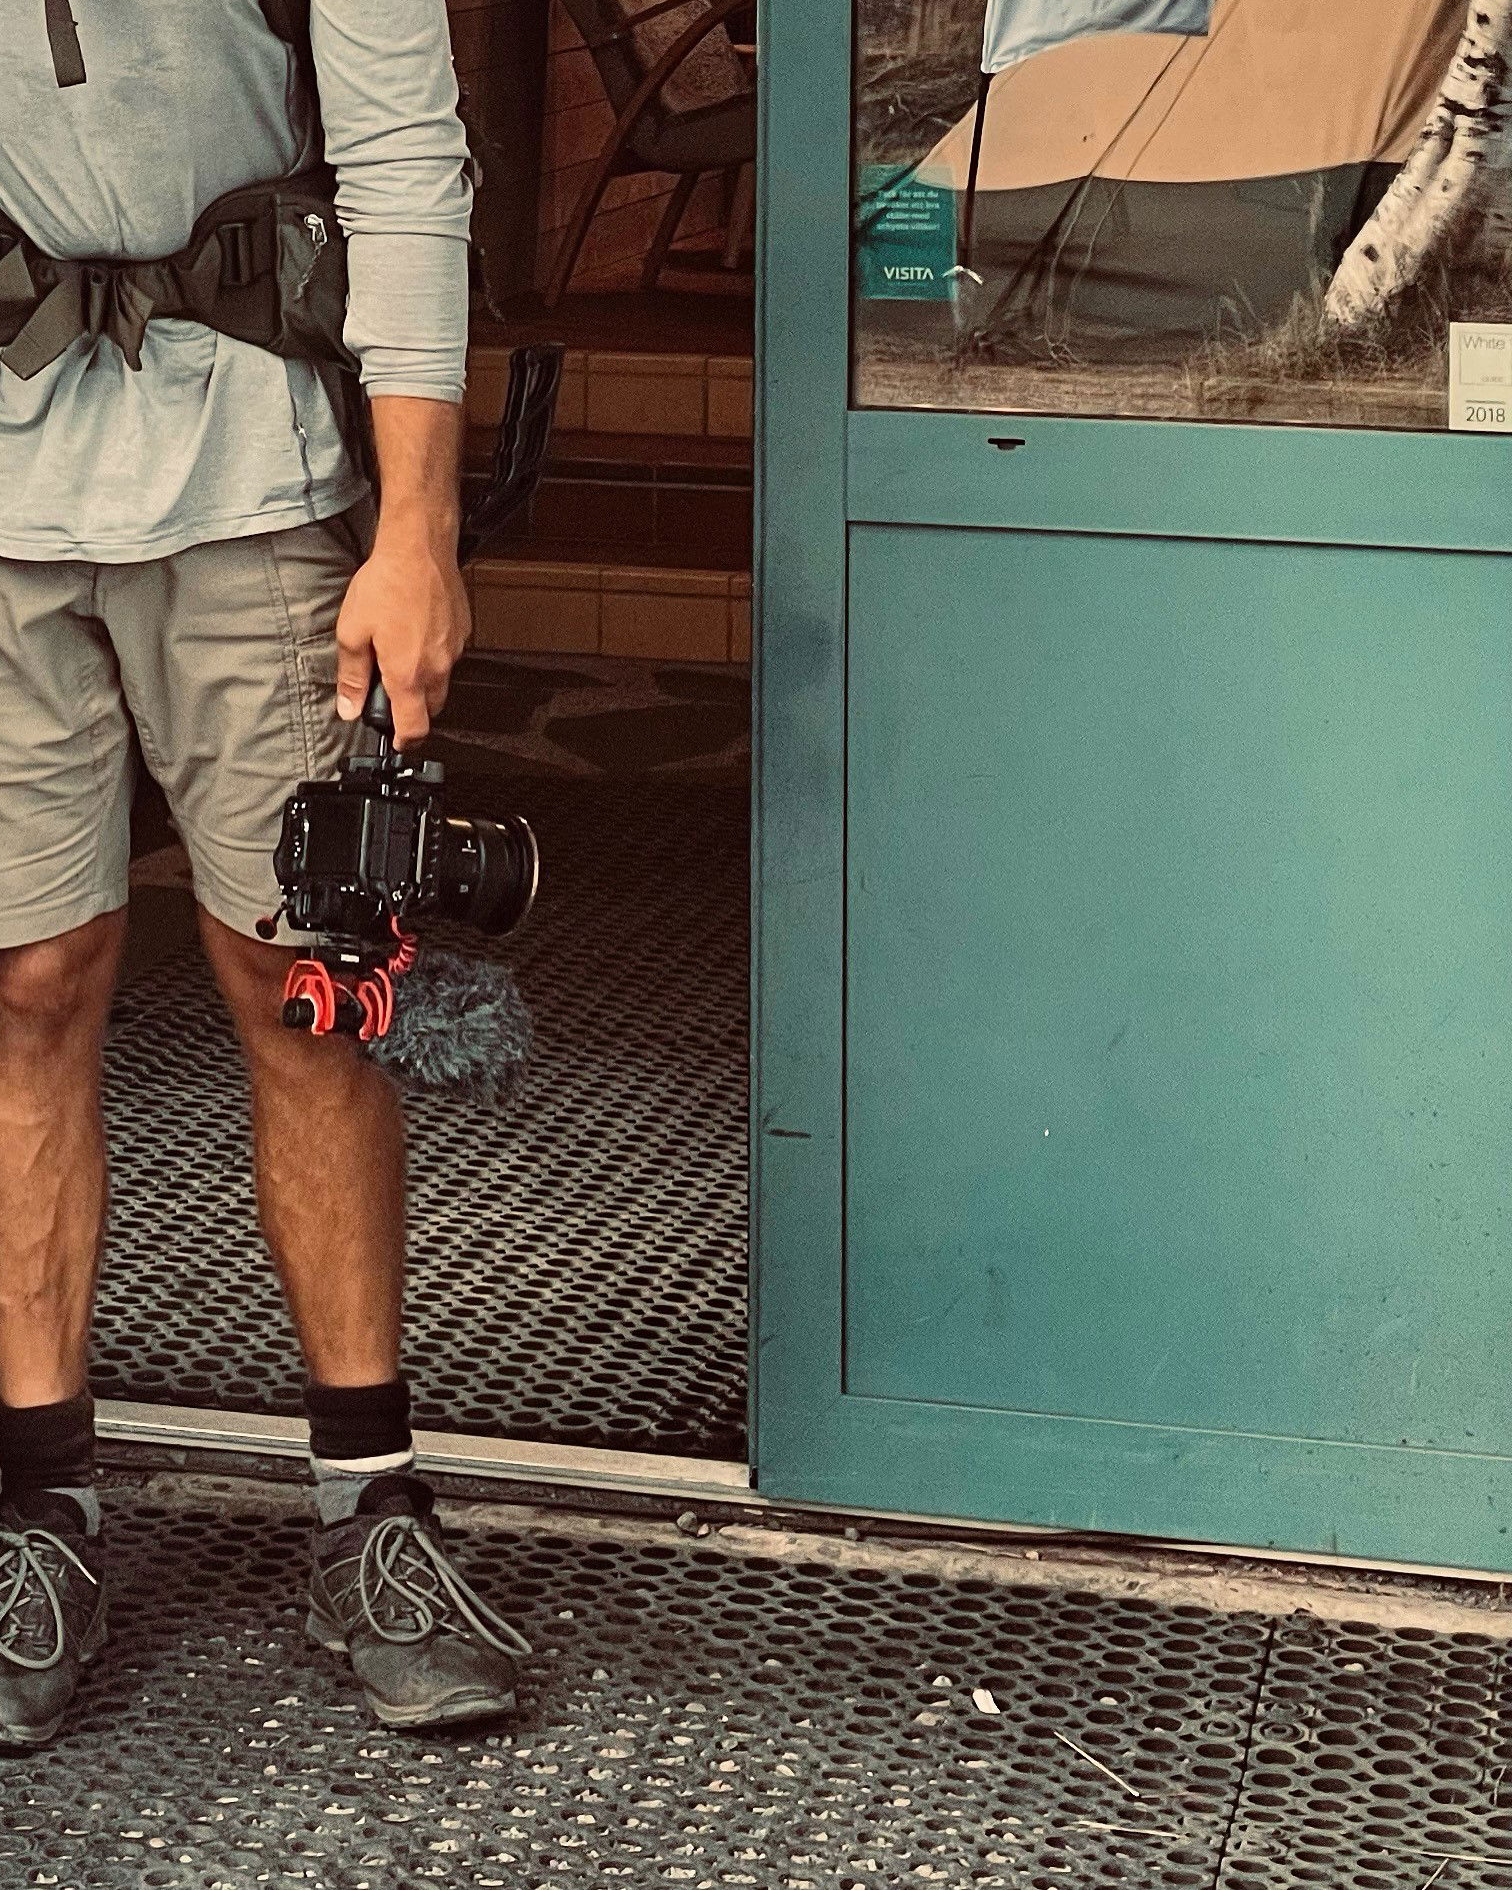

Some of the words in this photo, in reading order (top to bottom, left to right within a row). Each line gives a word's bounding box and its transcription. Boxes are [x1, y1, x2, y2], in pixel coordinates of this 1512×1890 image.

[883, 266, 934, 281] VISITA
[1463, 335, 1506, 351] White
[1466, 406, 1506, 423] 2018
